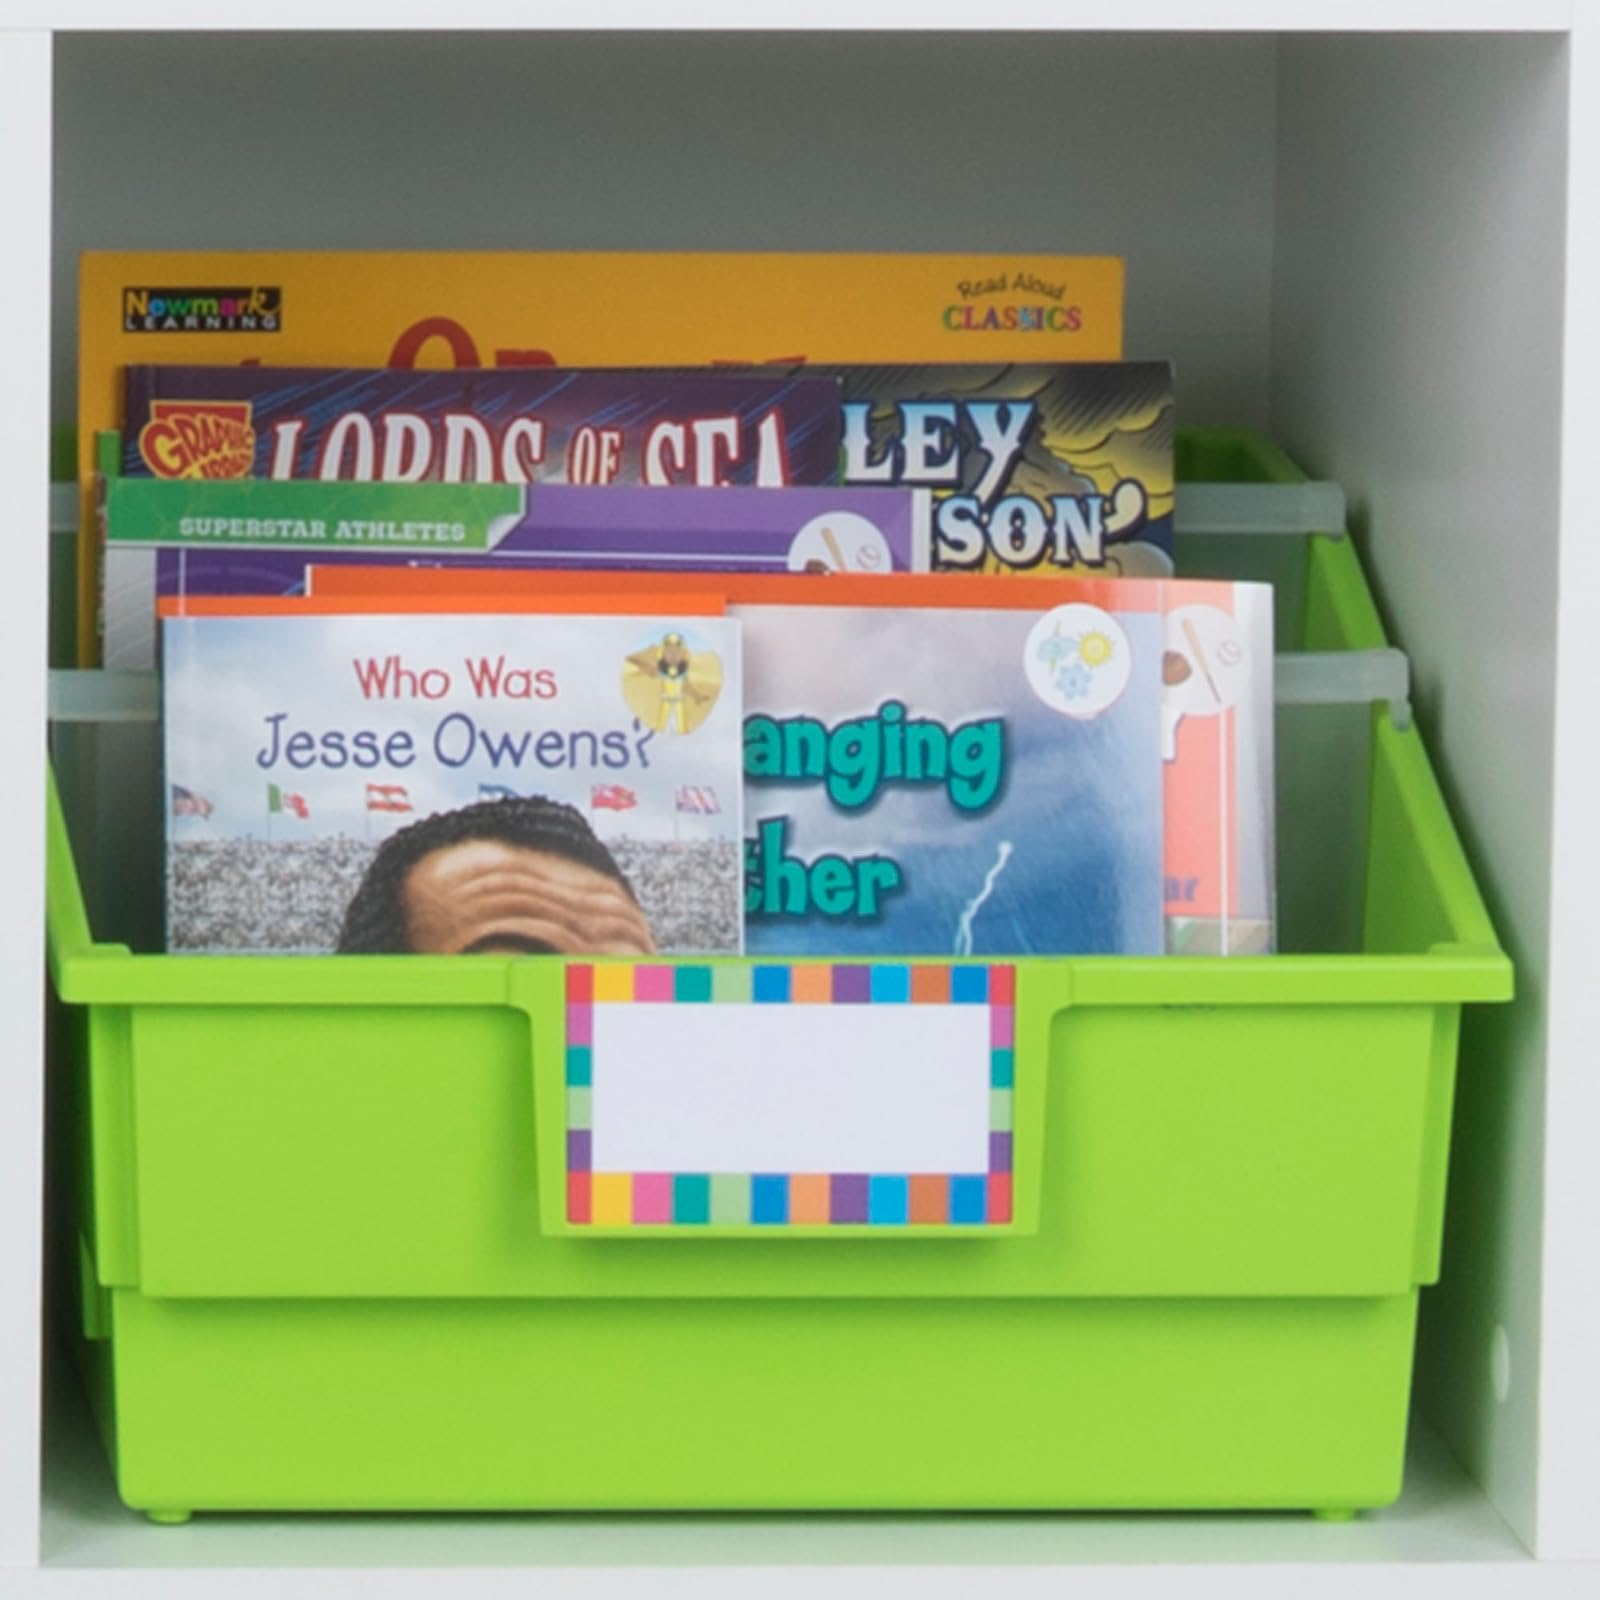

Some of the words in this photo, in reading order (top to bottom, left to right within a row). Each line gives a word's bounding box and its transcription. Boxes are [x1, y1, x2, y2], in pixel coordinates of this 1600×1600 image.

[957, 275, 1007, 300] Read
[1012, 272, 1067, 300] Aloud
[125, 315, 277, 330] LEARNING
[942, 304, 1082, 332] CLASSICS
[573, 427, 620, 486] OF
[179, 517, 326, 540] SUPERSTAR
[335, 520, 466, 543] ATHLETES
[353, 656, 450, 702] Who
[466, 655, 558, 702] Was
[256, 713, 417, 770] Jesse
[434, 712, 655, 769] Owens?
[743, 699, 1005, 812] anging
